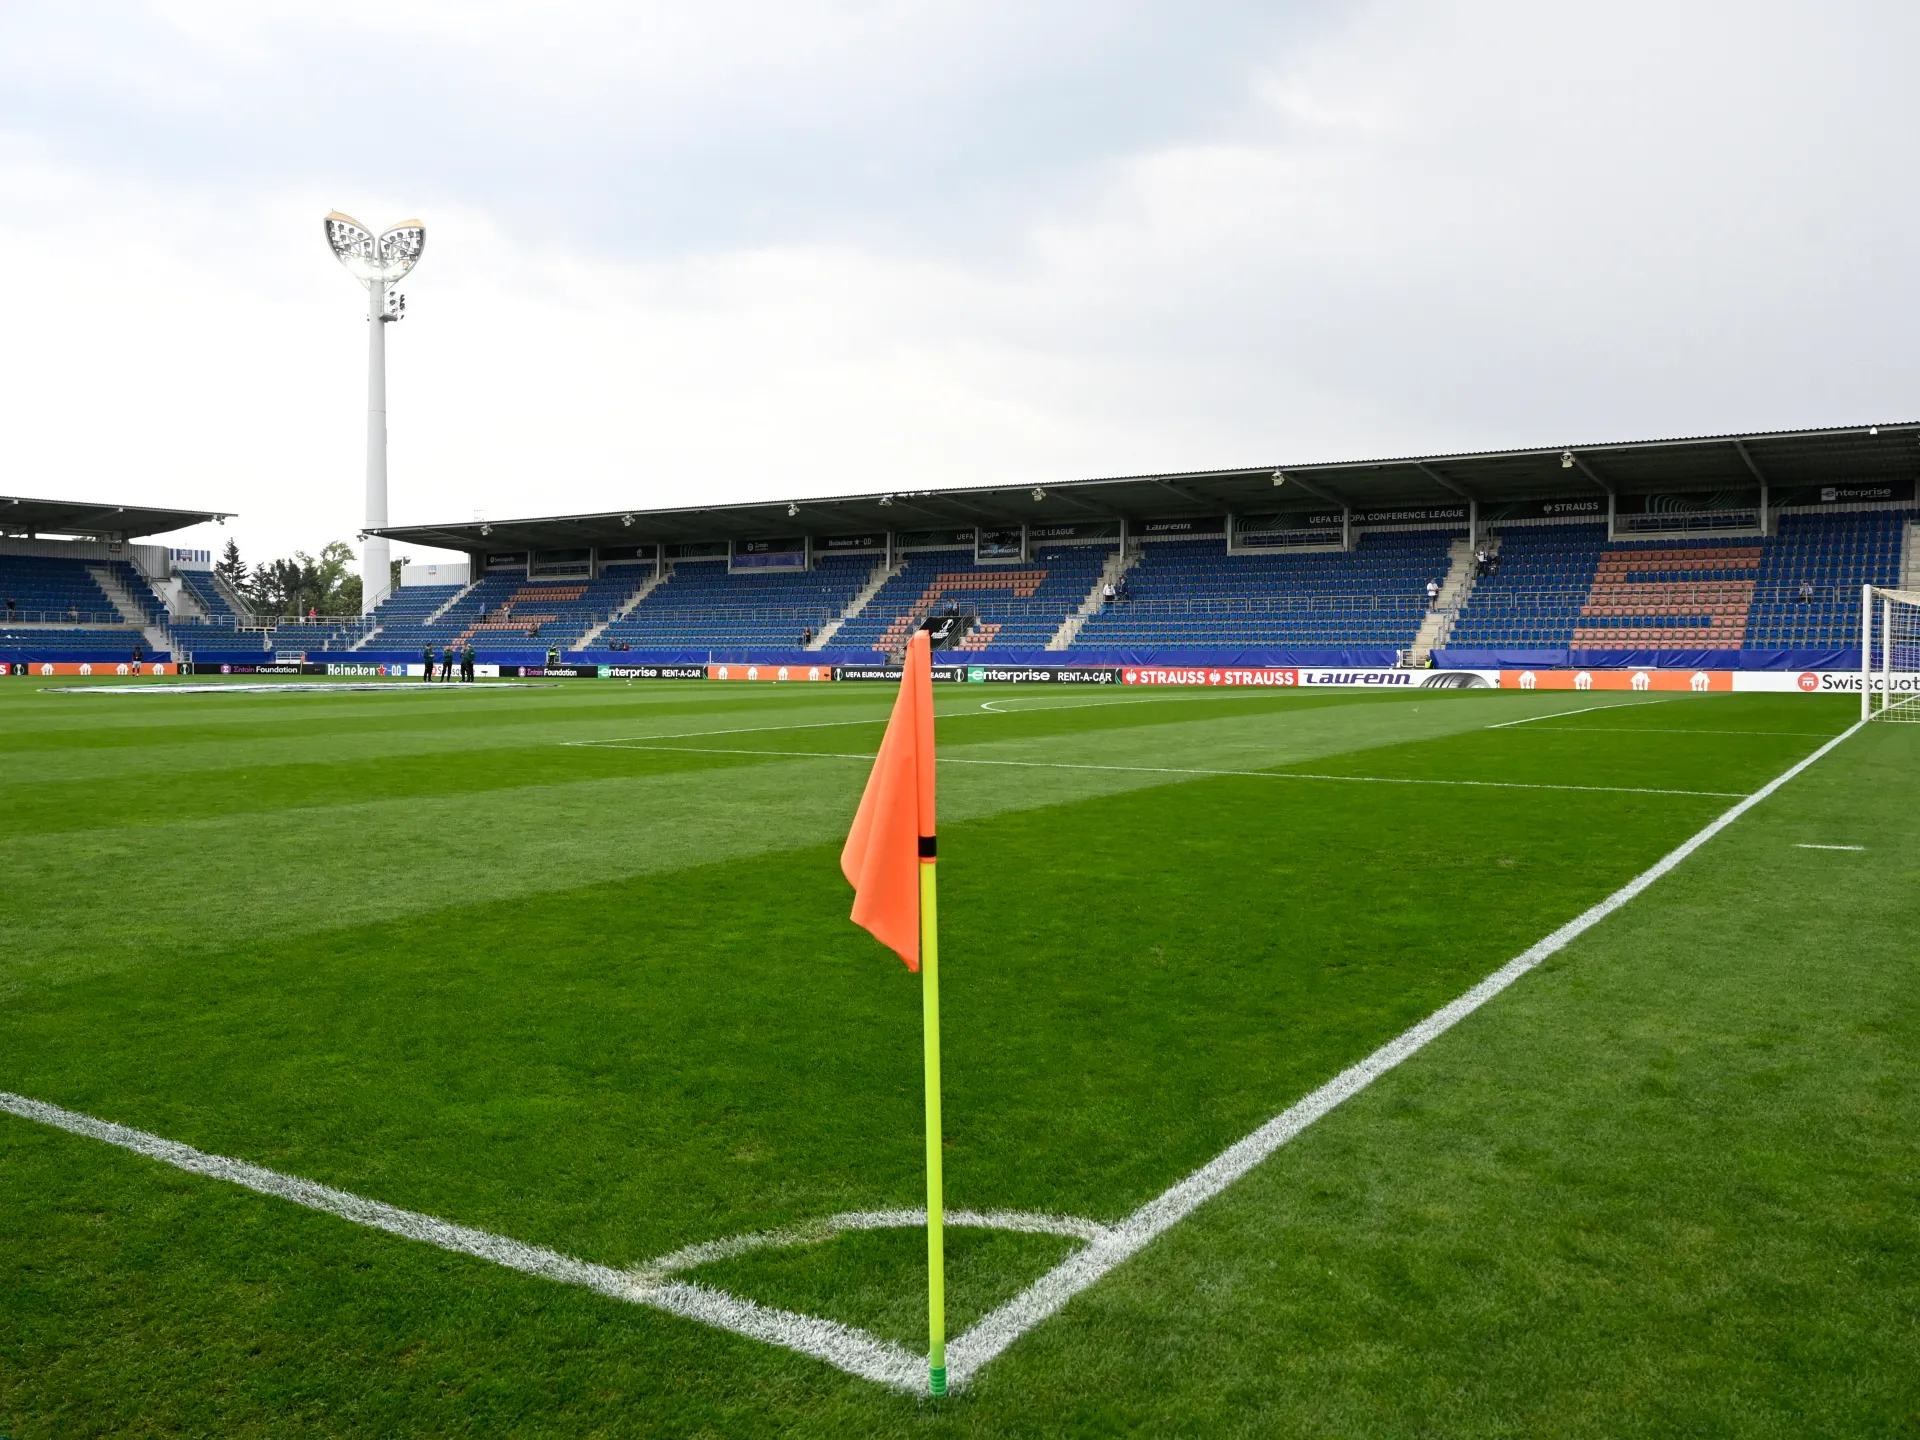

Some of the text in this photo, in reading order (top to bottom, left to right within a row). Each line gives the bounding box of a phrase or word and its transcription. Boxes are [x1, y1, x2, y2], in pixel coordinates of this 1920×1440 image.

[1825, 487, 1891, 498] enterprise
[1554, 502, 1599, 512] STRAUSS
[1333, 514, 1365, 522] EUOPA
[1367, 511, 1426, 521] CONFERENCE
[1429, 509, 1464, 518] LEAGUE
[1047, 527, 1075, 536] LEAGUE
[256, 665, 298, 674] Foundation
[327, 663, 376, 676] Heineken
[544, 668, 578, 677] Foundation
[599, 667, 701, 679] enterprise RENT-A-CAR
[970, 669, 1112, 683] enterprise RENT-A-CAR
[1140, 671, 1294, 685] STRAUSS STRAUSS
